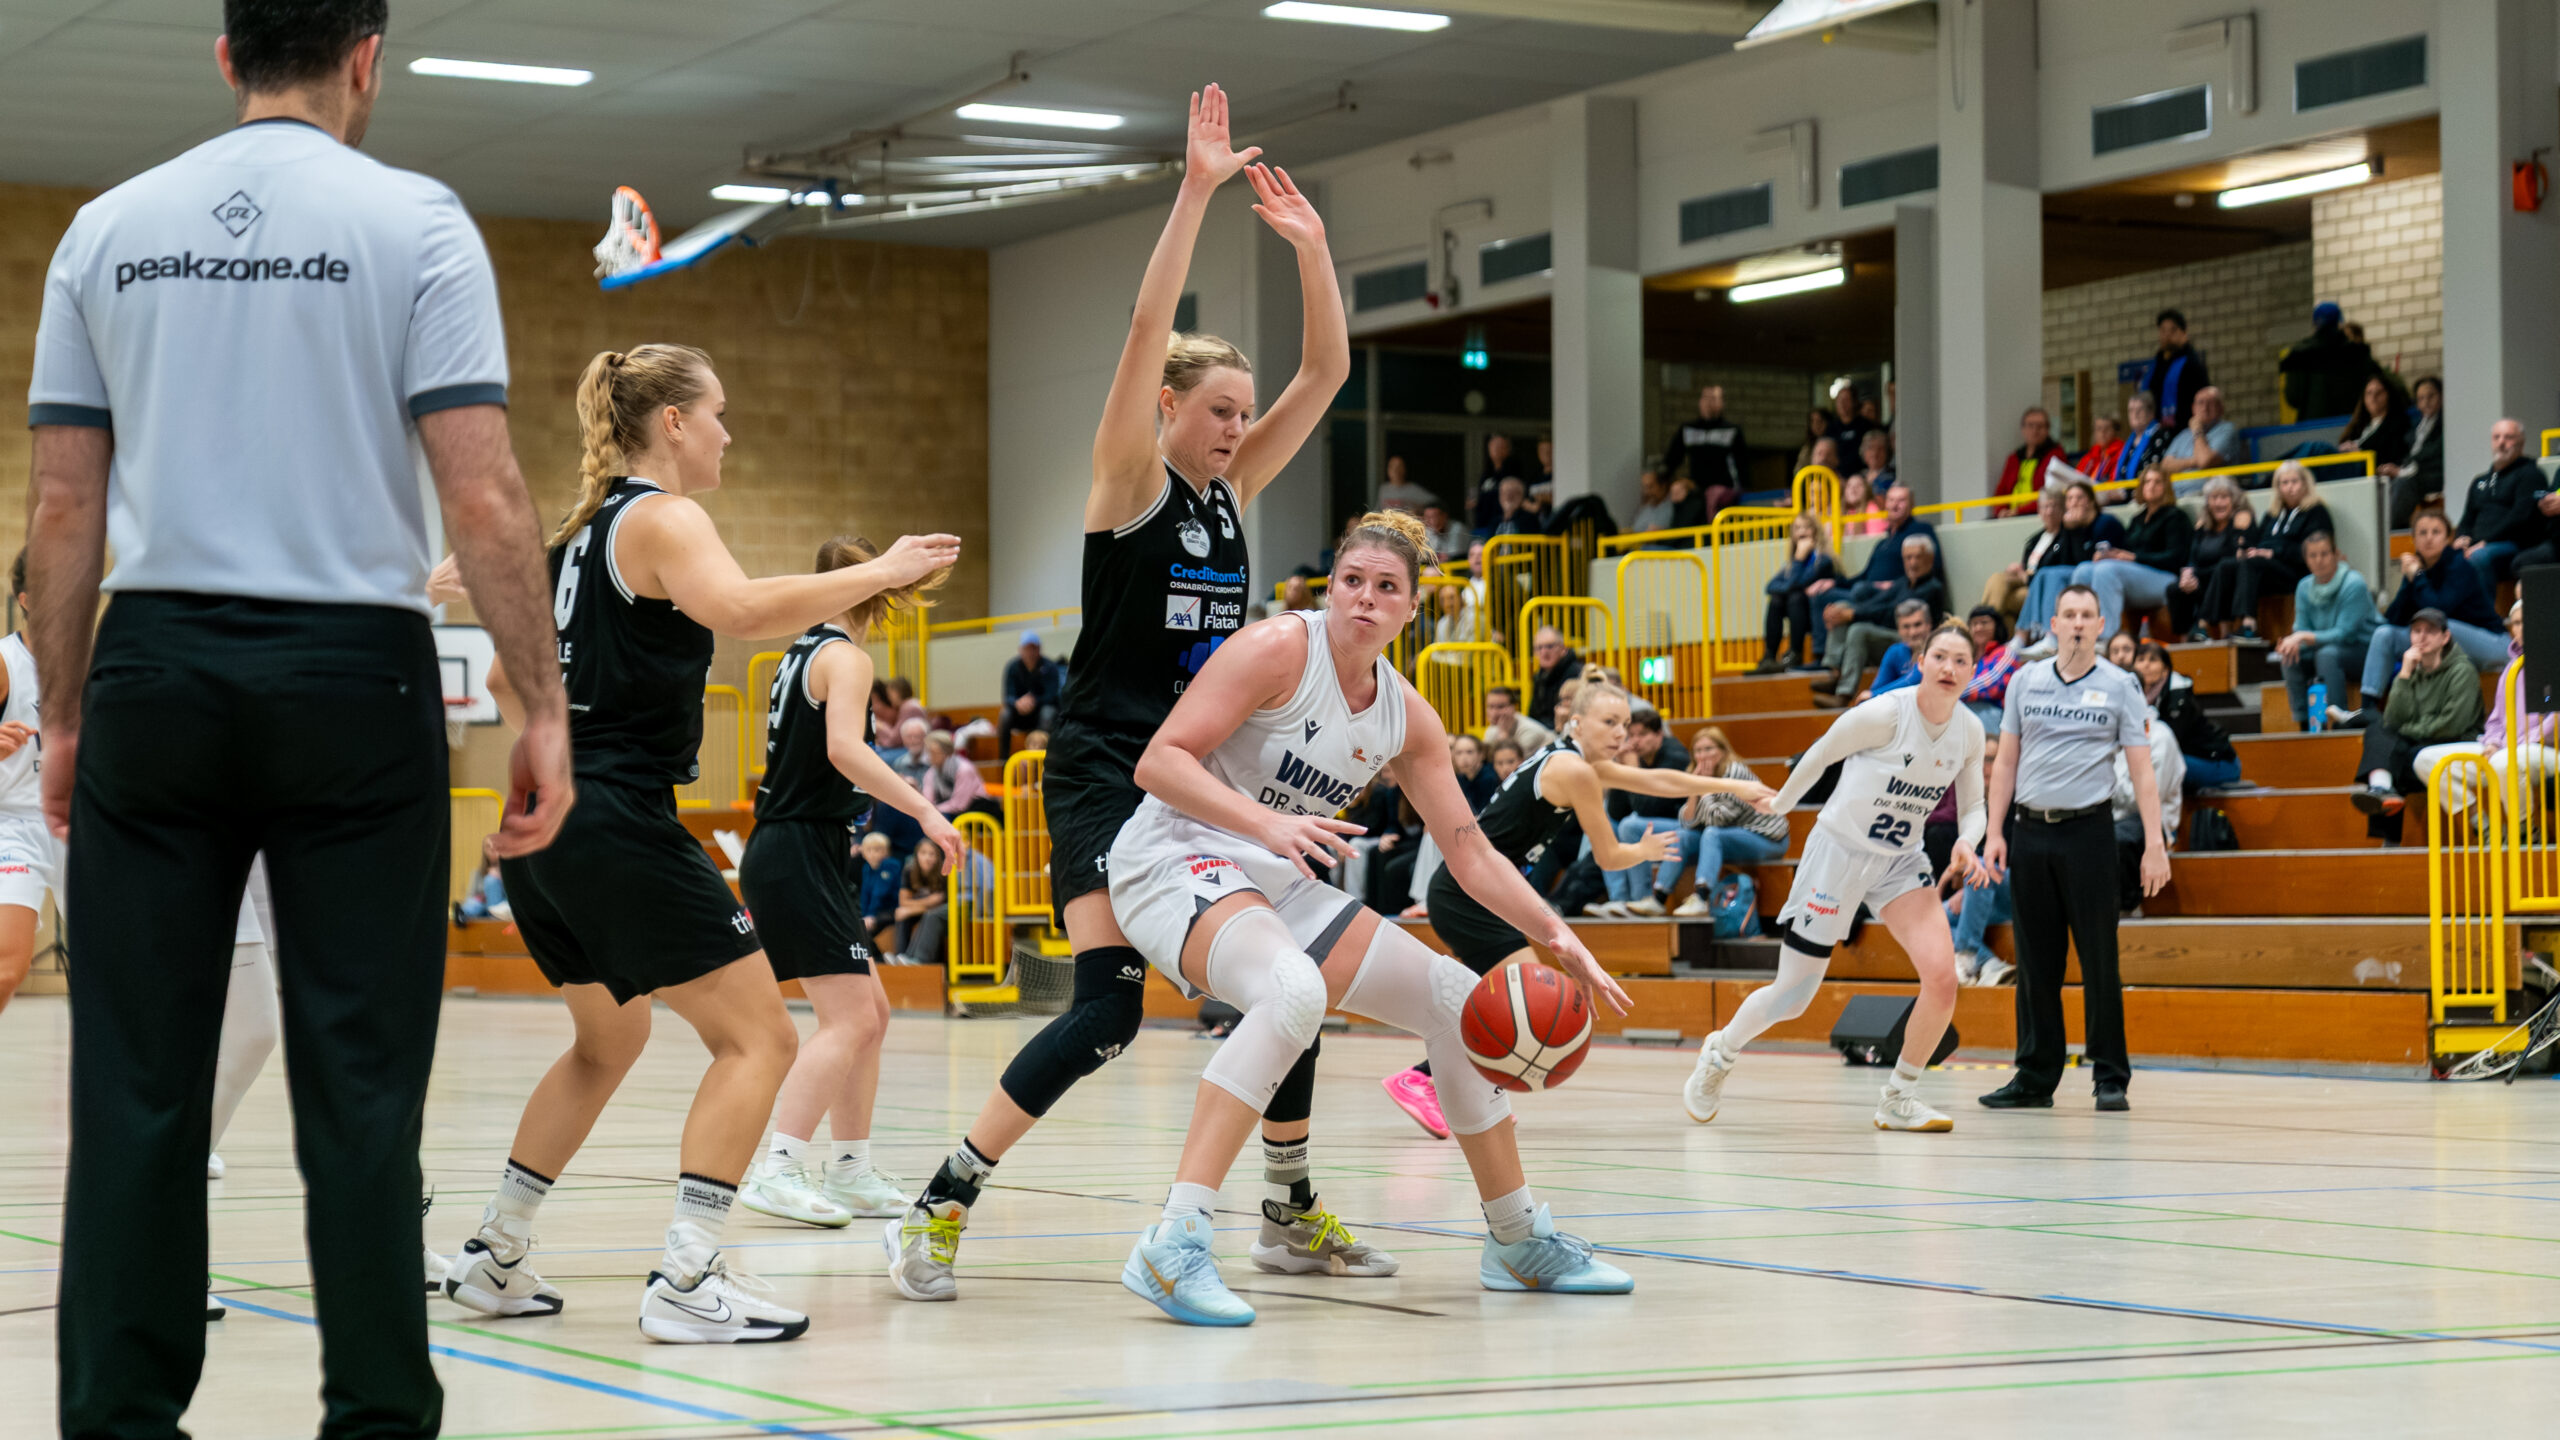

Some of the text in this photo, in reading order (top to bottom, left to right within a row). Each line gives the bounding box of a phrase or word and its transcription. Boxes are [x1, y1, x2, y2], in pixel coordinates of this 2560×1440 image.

[116, 250, 350, 292] peakzone.de
[554, 525, 592, 631] 6
[1166, 612, 1193, 627] AXA
[2024, 704, 2108, 726] peakzone
[1886, 775, 1946, 801] WINGS
[1868, 812, 1912, 848] 22
